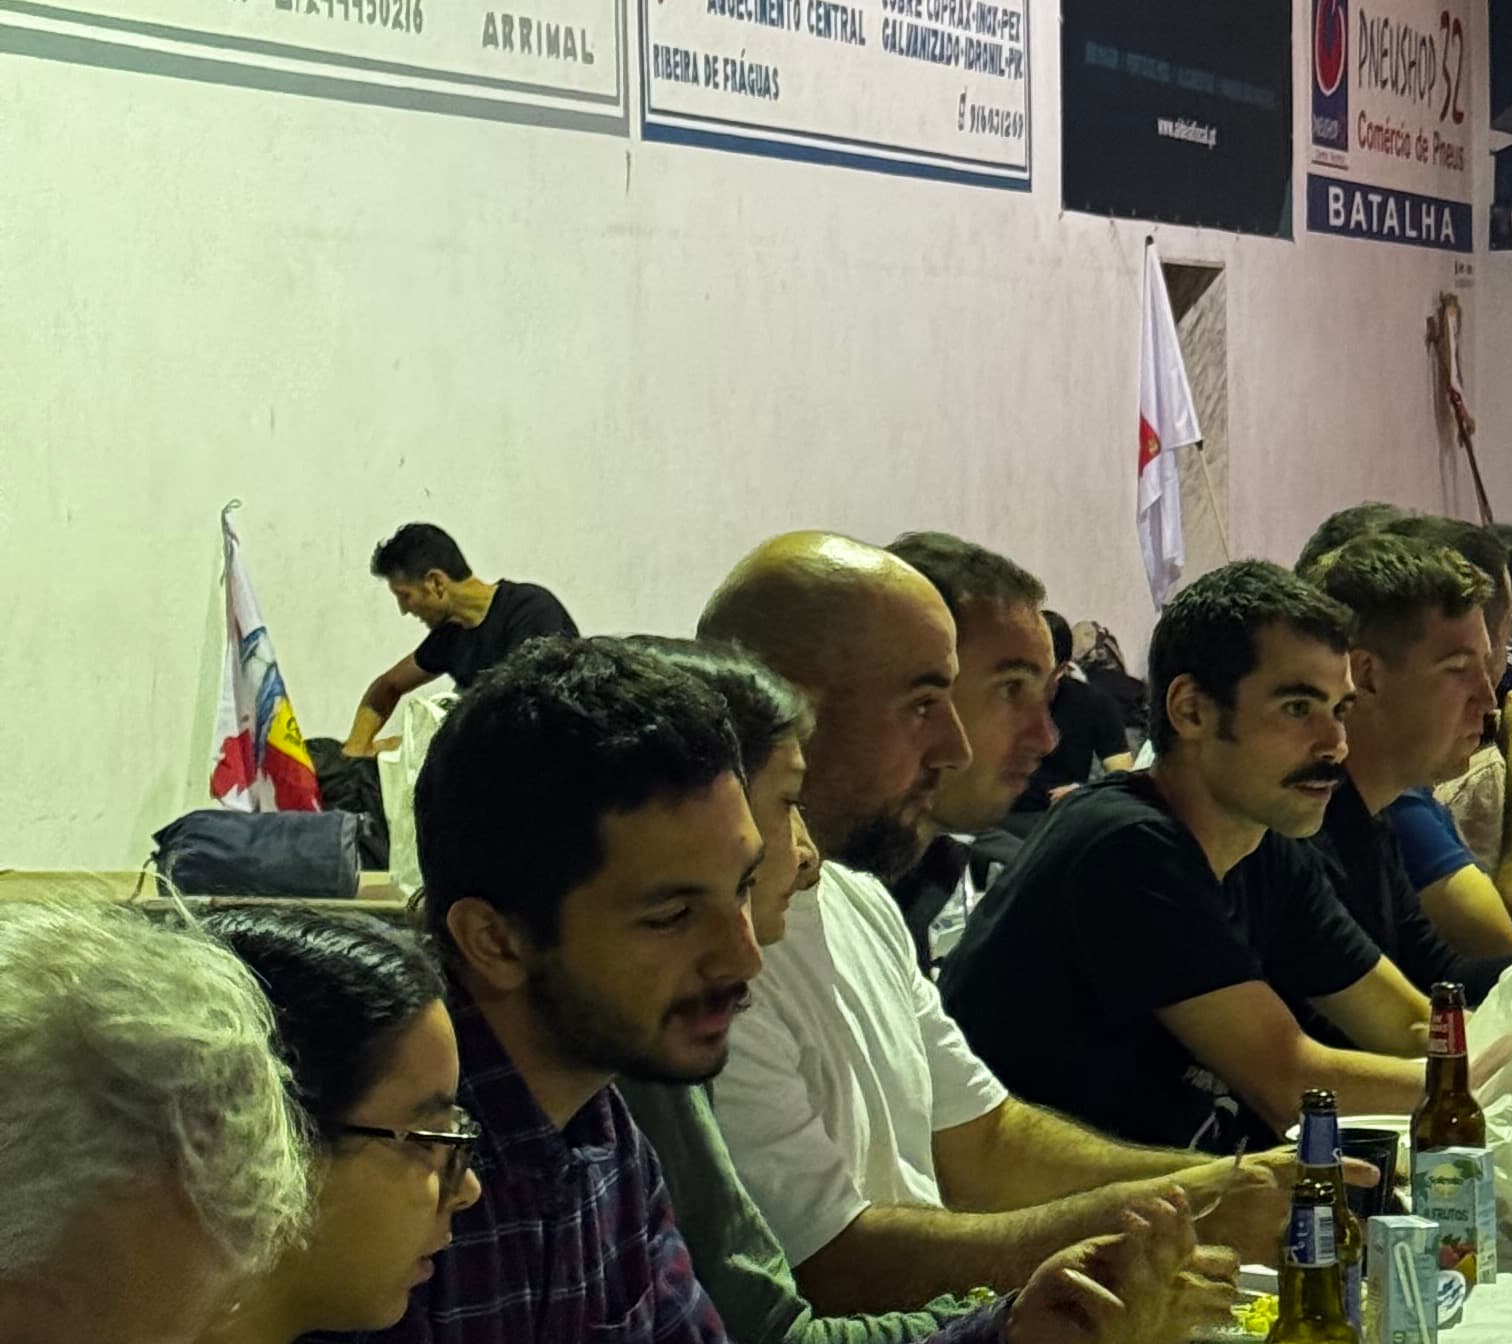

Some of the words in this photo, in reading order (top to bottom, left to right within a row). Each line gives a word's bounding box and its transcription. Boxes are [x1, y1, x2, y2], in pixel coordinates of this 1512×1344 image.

[482, 12, 595, 65] ARRIMAL
[1358, 8, 1437, 108] PNEUSHOP
[1439, 10, 1465, 125] 32
[653, 43, 700, 87] RIBEIRA
[703, 53, 720, 90] DE
[723, 48, 780, 102] FRÁGUAS
[1415, 128, 1429, 164] de
[1327, 184, 1456, 245] BATALHA
